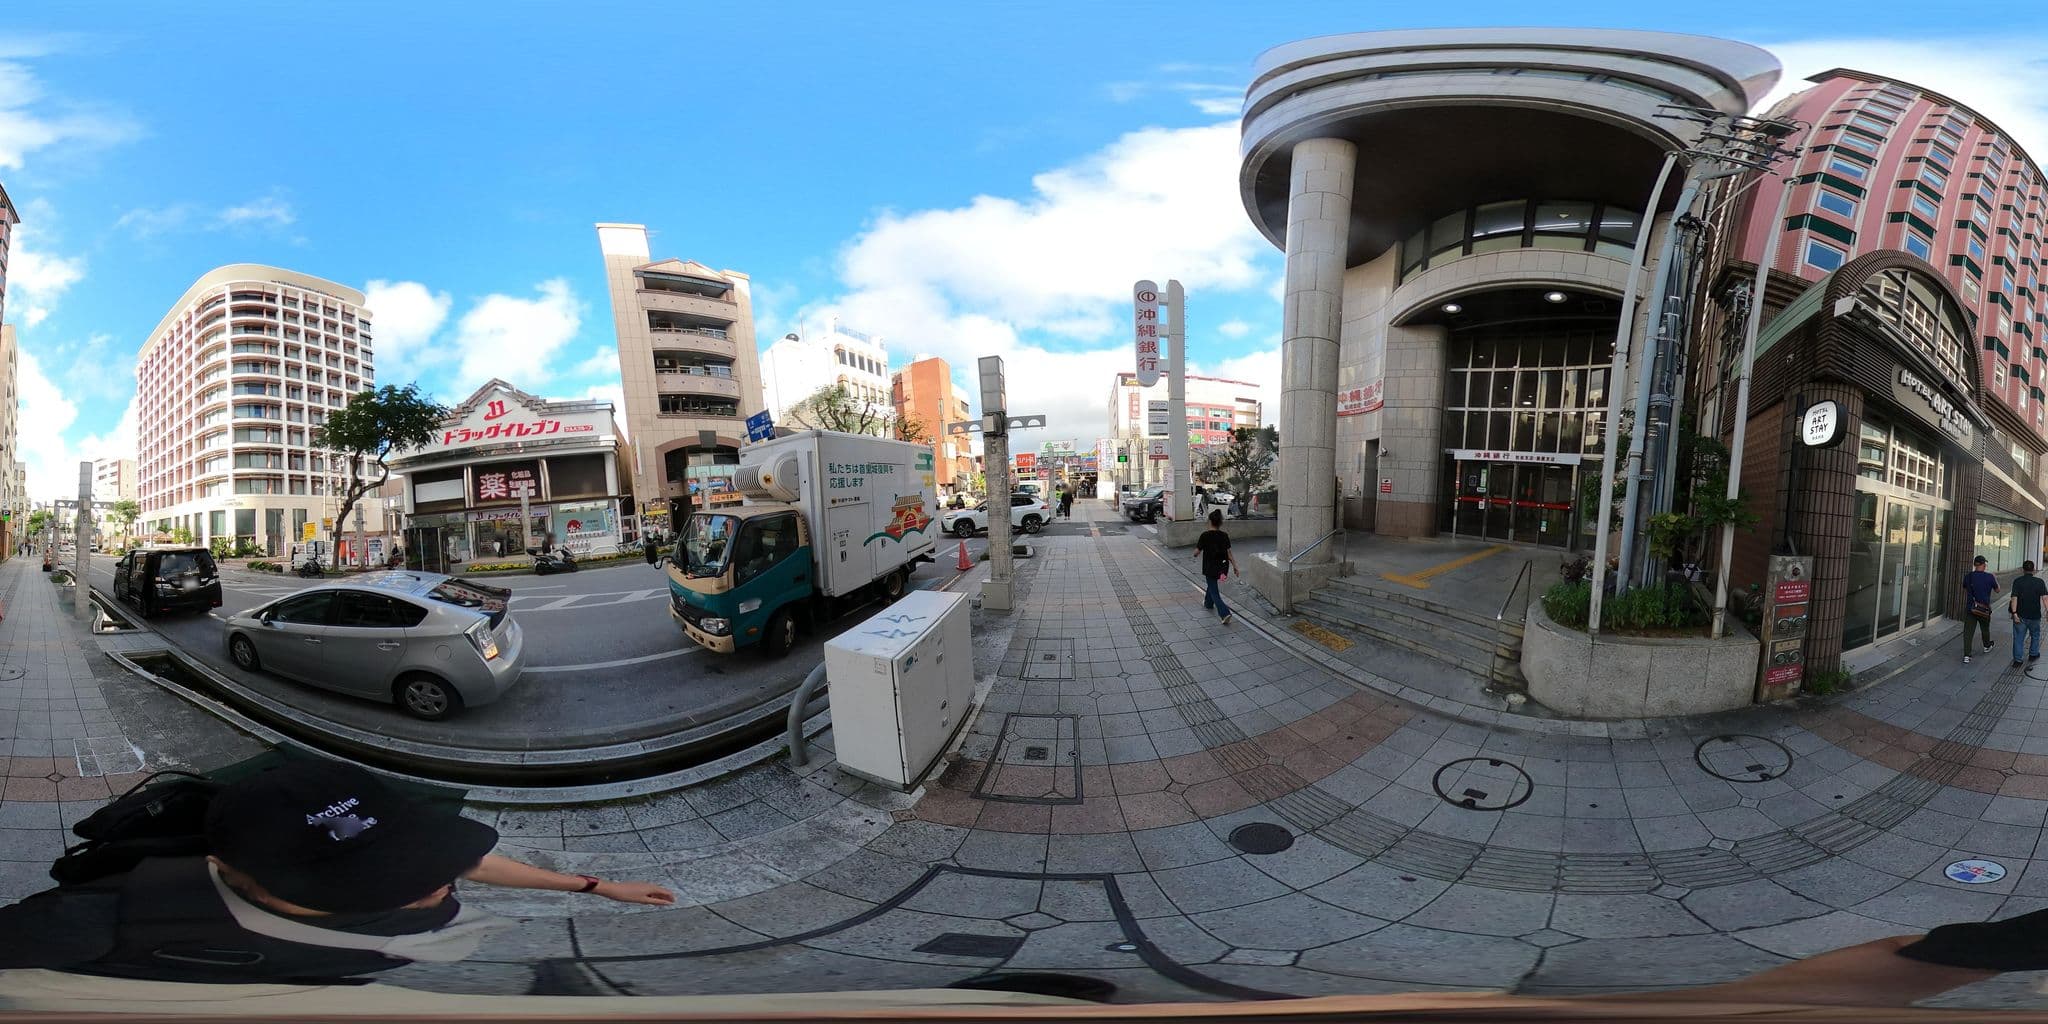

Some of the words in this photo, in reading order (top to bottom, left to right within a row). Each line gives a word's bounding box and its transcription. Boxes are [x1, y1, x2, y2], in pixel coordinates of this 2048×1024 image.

[1138, 308, 1157, 371] 沖縄銀行
[1812, 414, 1827, 426] ART
[1932, 393, 1953, 420] ART
[1951, 410, 1973, 436] STAY
[443, 419, 561, 446] ドラッグイレブン
[1809, 423, 1828, 435] STAY
[828, 462, 893, 474] 私たちは首里城復興を
[480, 473, 507, 499] 薬
[829, 477, 864, 489] 応援します
